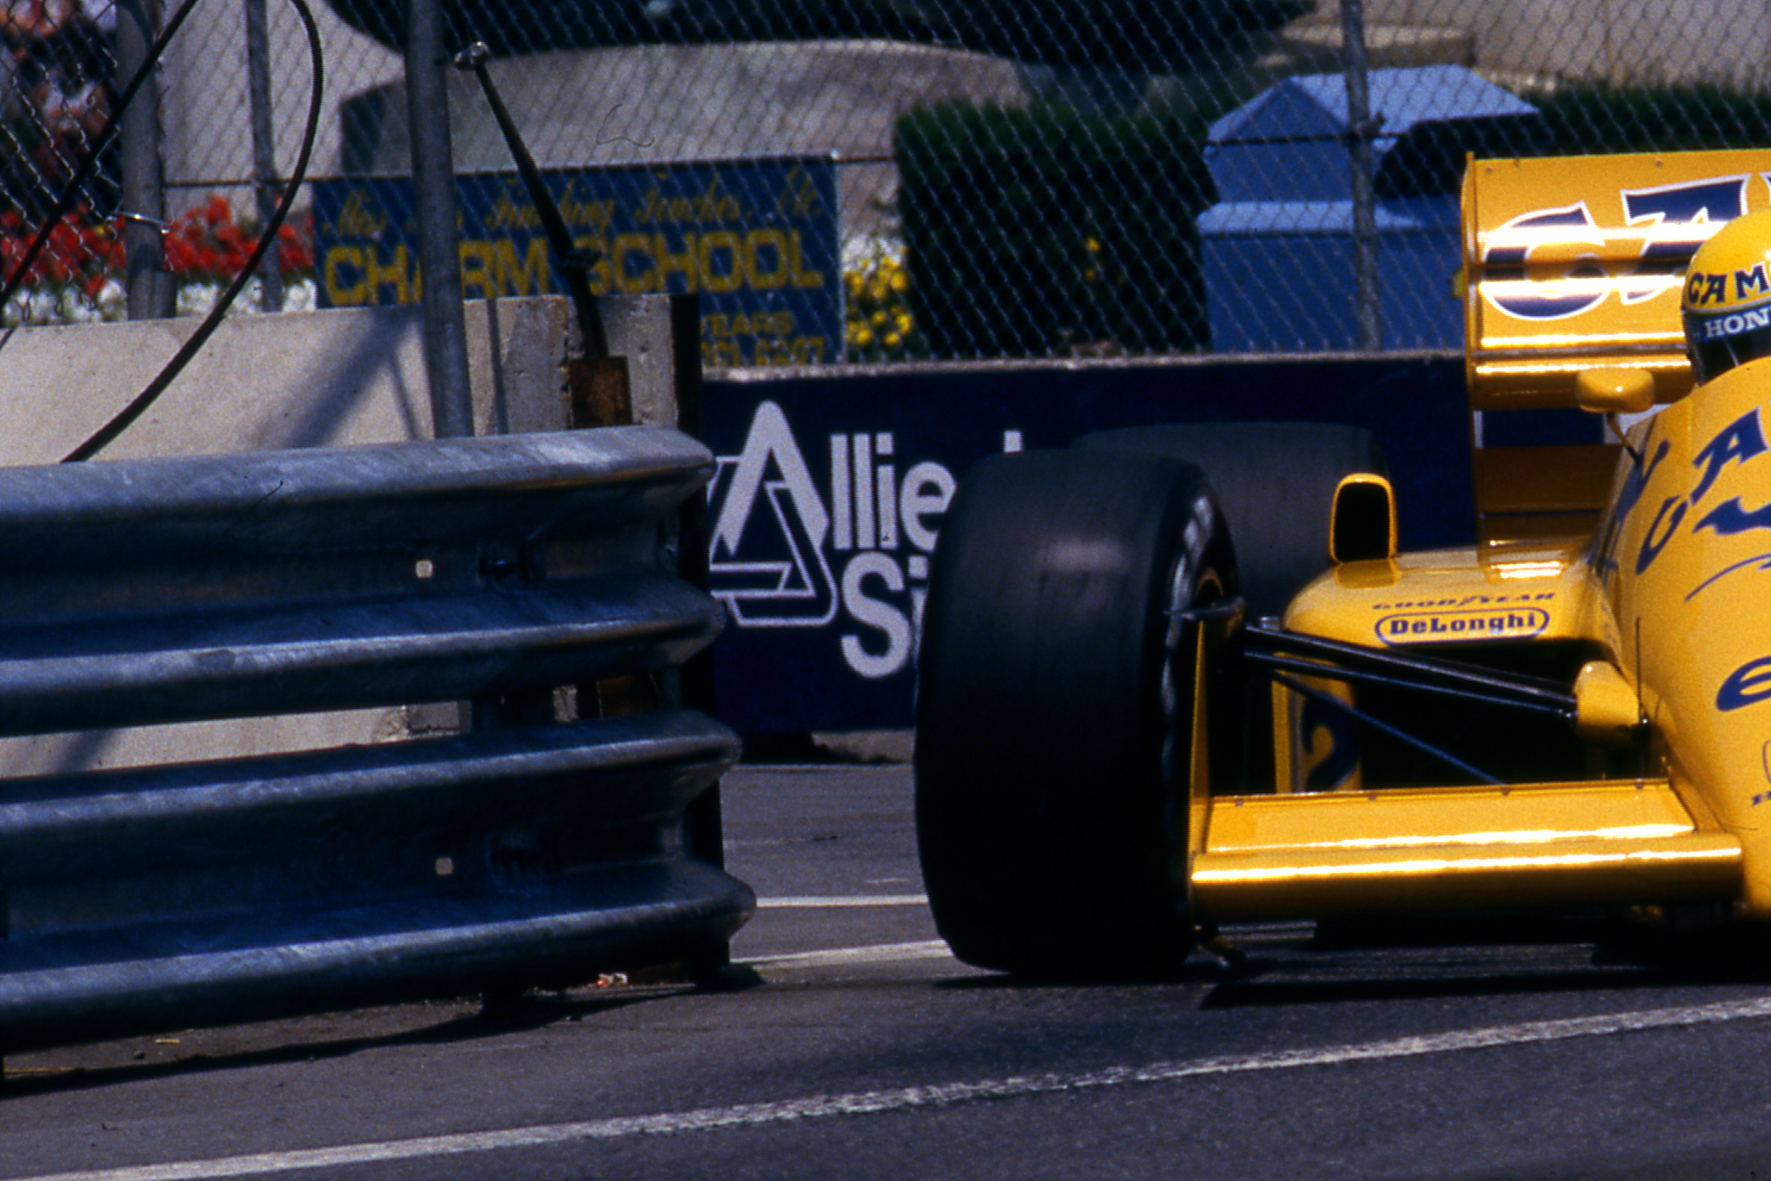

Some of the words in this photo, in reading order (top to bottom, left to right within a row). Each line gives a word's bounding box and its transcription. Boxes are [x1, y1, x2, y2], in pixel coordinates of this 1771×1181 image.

[324, 235, 549, 306] CHRM
[573, 229, 824, 295] SCHOOL
[1389, 612, 1536, 636] DeLonghi
